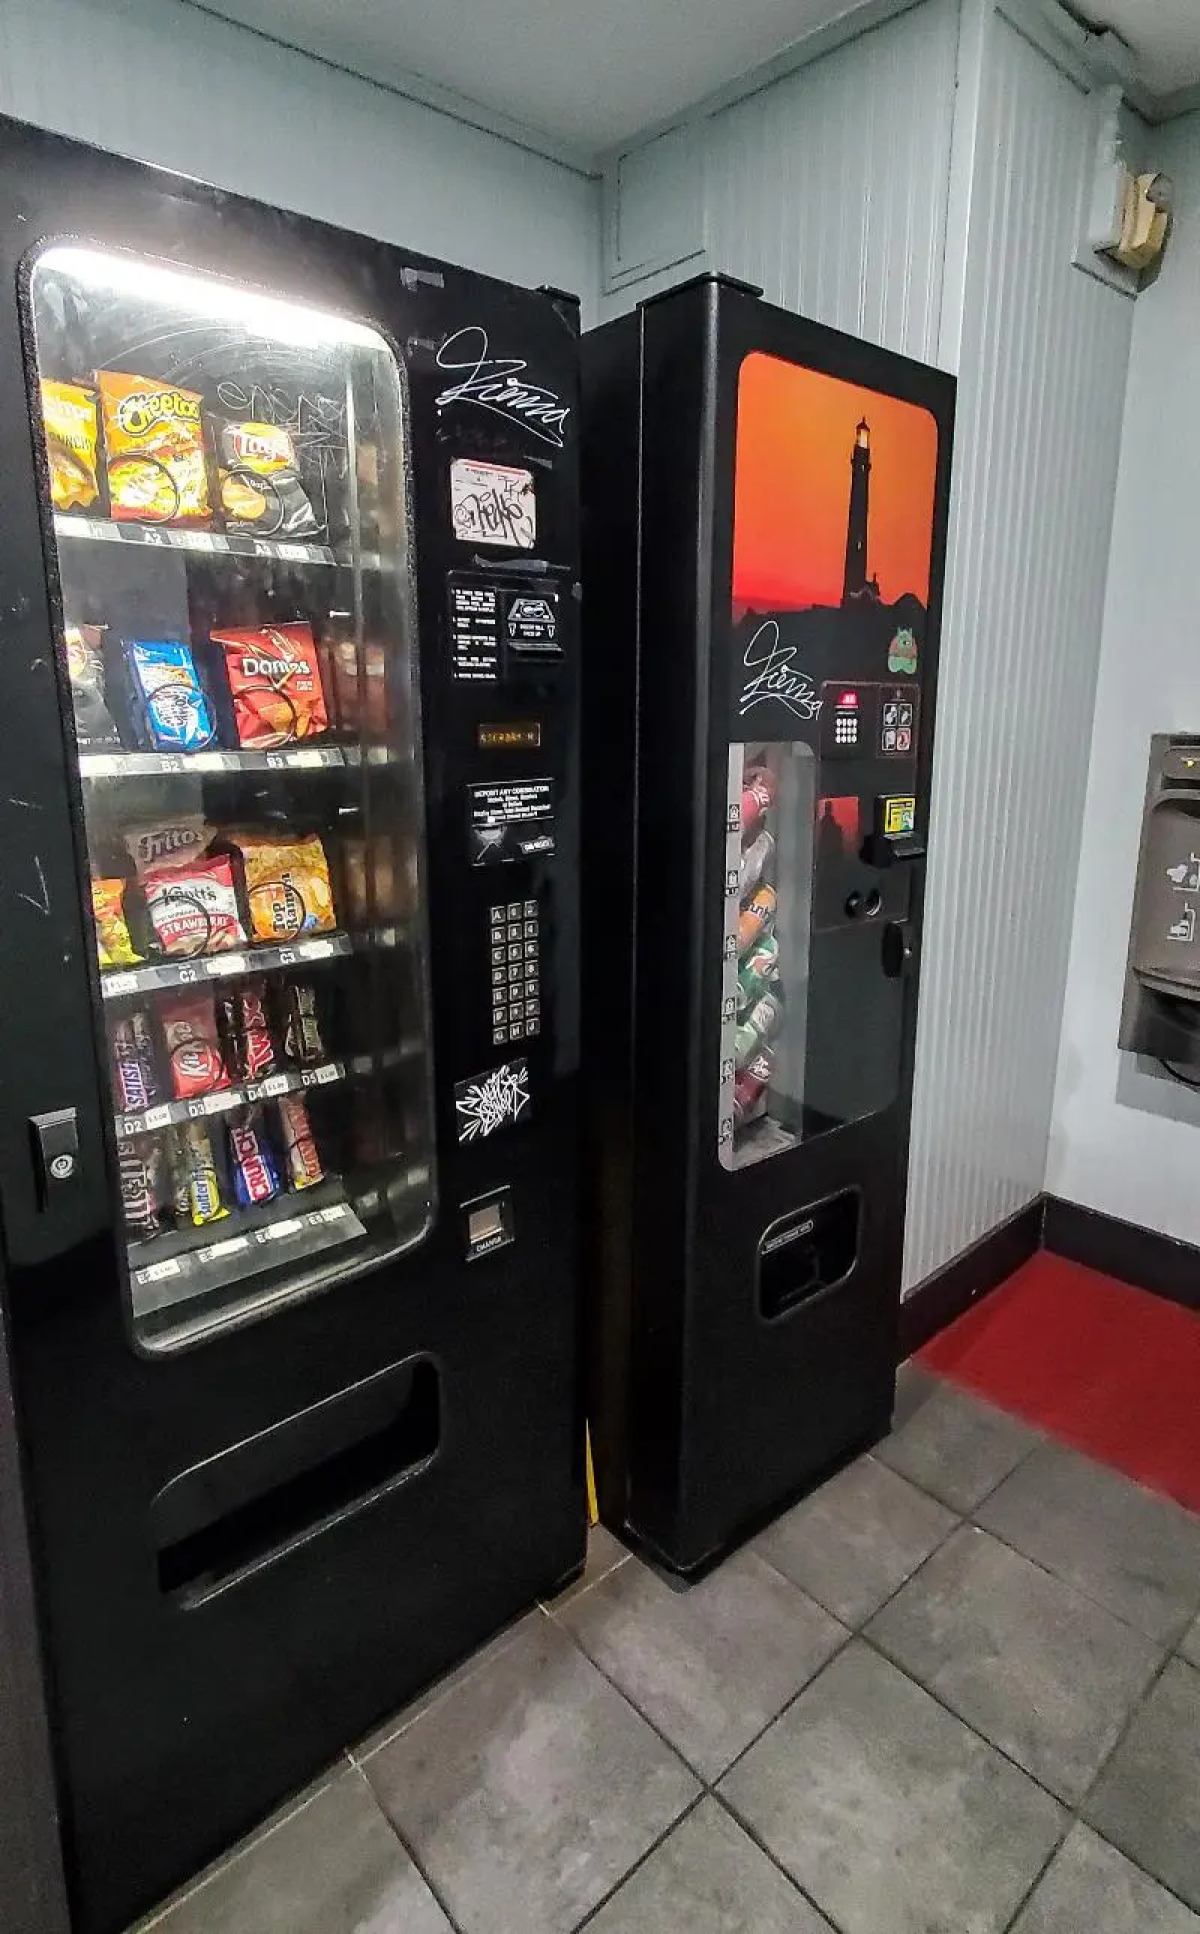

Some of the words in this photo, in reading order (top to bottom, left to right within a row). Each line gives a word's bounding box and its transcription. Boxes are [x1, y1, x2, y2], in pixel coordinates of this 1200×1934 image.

[273, 903, 285, 932] Top
[189, 1104, 206, 1117] D3
[124, 1120, 142, 1135] D2
[234, 1129, 269, 1200] CRUNCH
